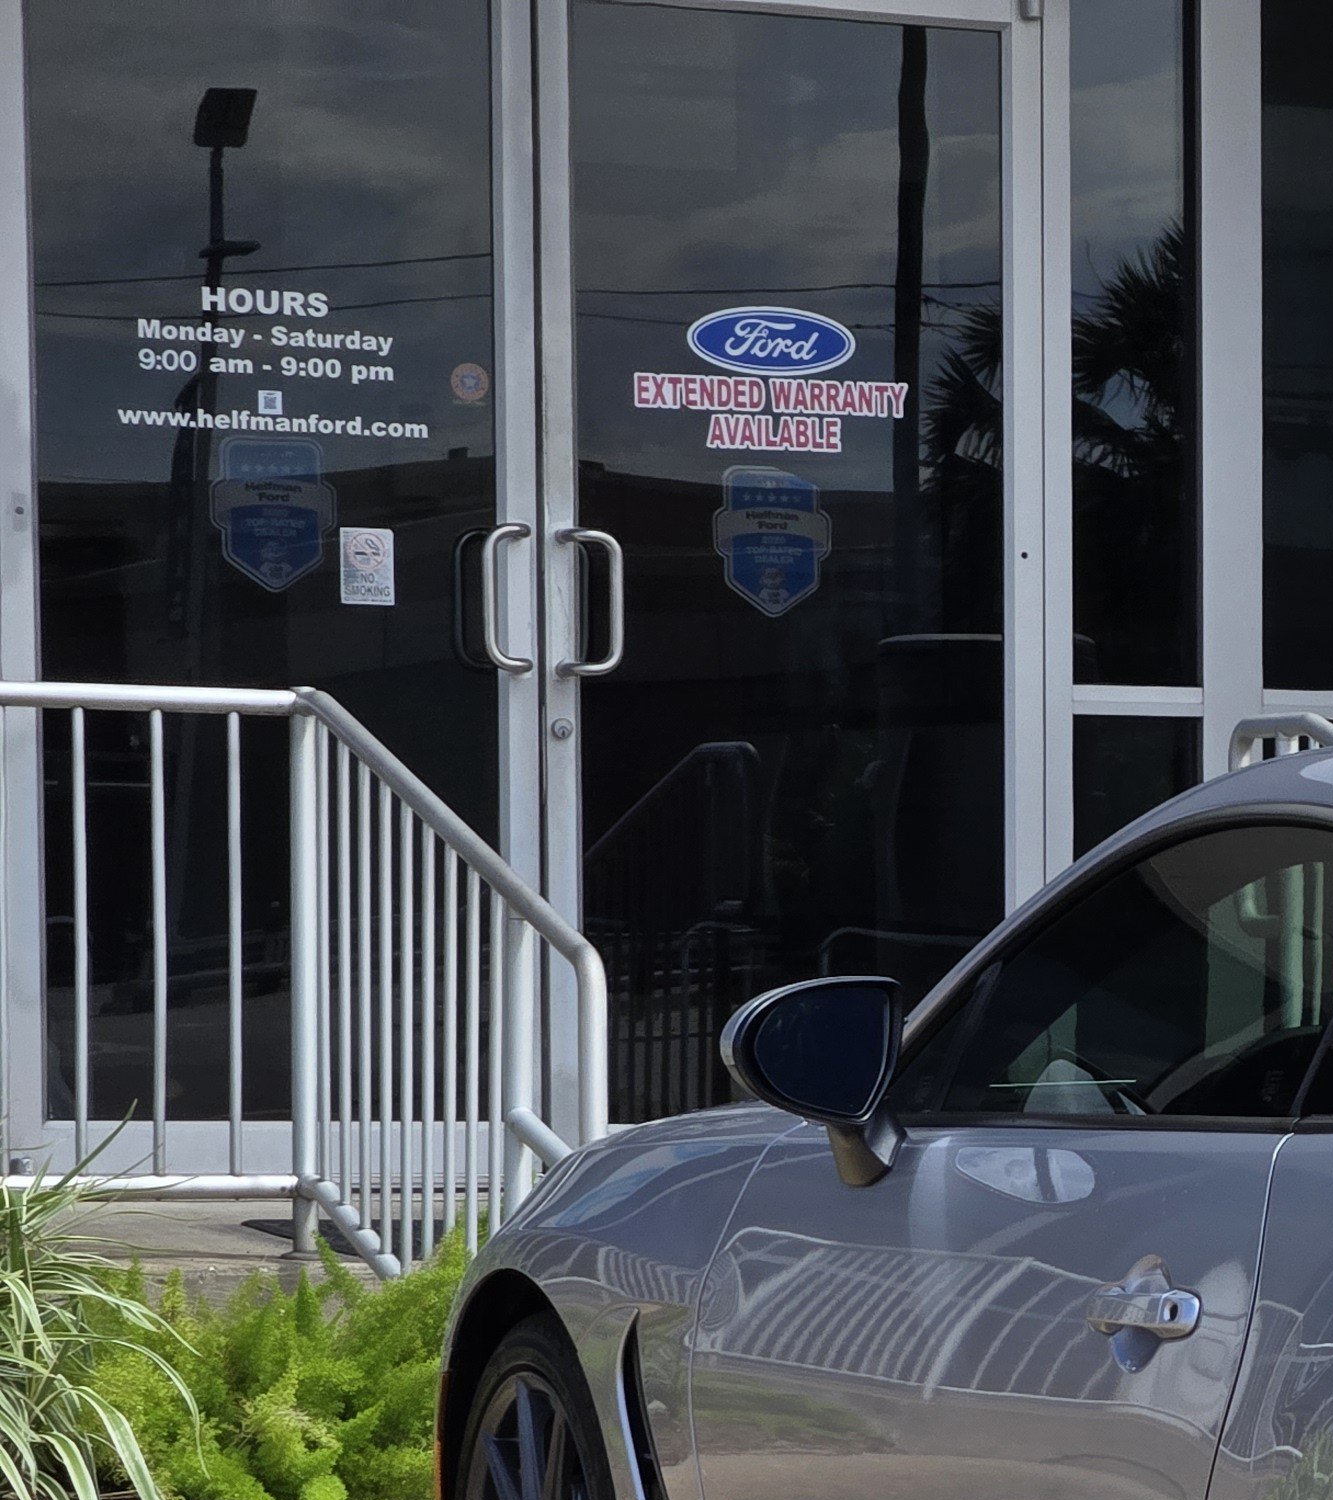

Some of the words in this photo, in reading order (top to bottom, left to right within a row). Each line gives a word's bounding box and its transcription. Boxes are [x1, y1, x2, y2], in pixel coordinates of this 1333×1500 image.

[200, 286, 329, 317] HOURS
[137, 319, 245, 347] Monday
[271, 326, 393, 356] Saturday
[724, 318, 819, 362] Ford
[139, 348, 196, 372] 9:00
[209, 356, 253, 375] am
[281, 356, 341, 379] 9:00
[351, 363, 394, 383] pm
[634, 373, 765, 412] EXTENDED
[771, 378, 908, 418] WARRANTY
[117, 407, 429, 439] www.helfmanford.com
[706, 414, 842, 452] AVAILABLE
[344, 585, 391, 597] SMOKING
[361, 573, 375, 584] NO
